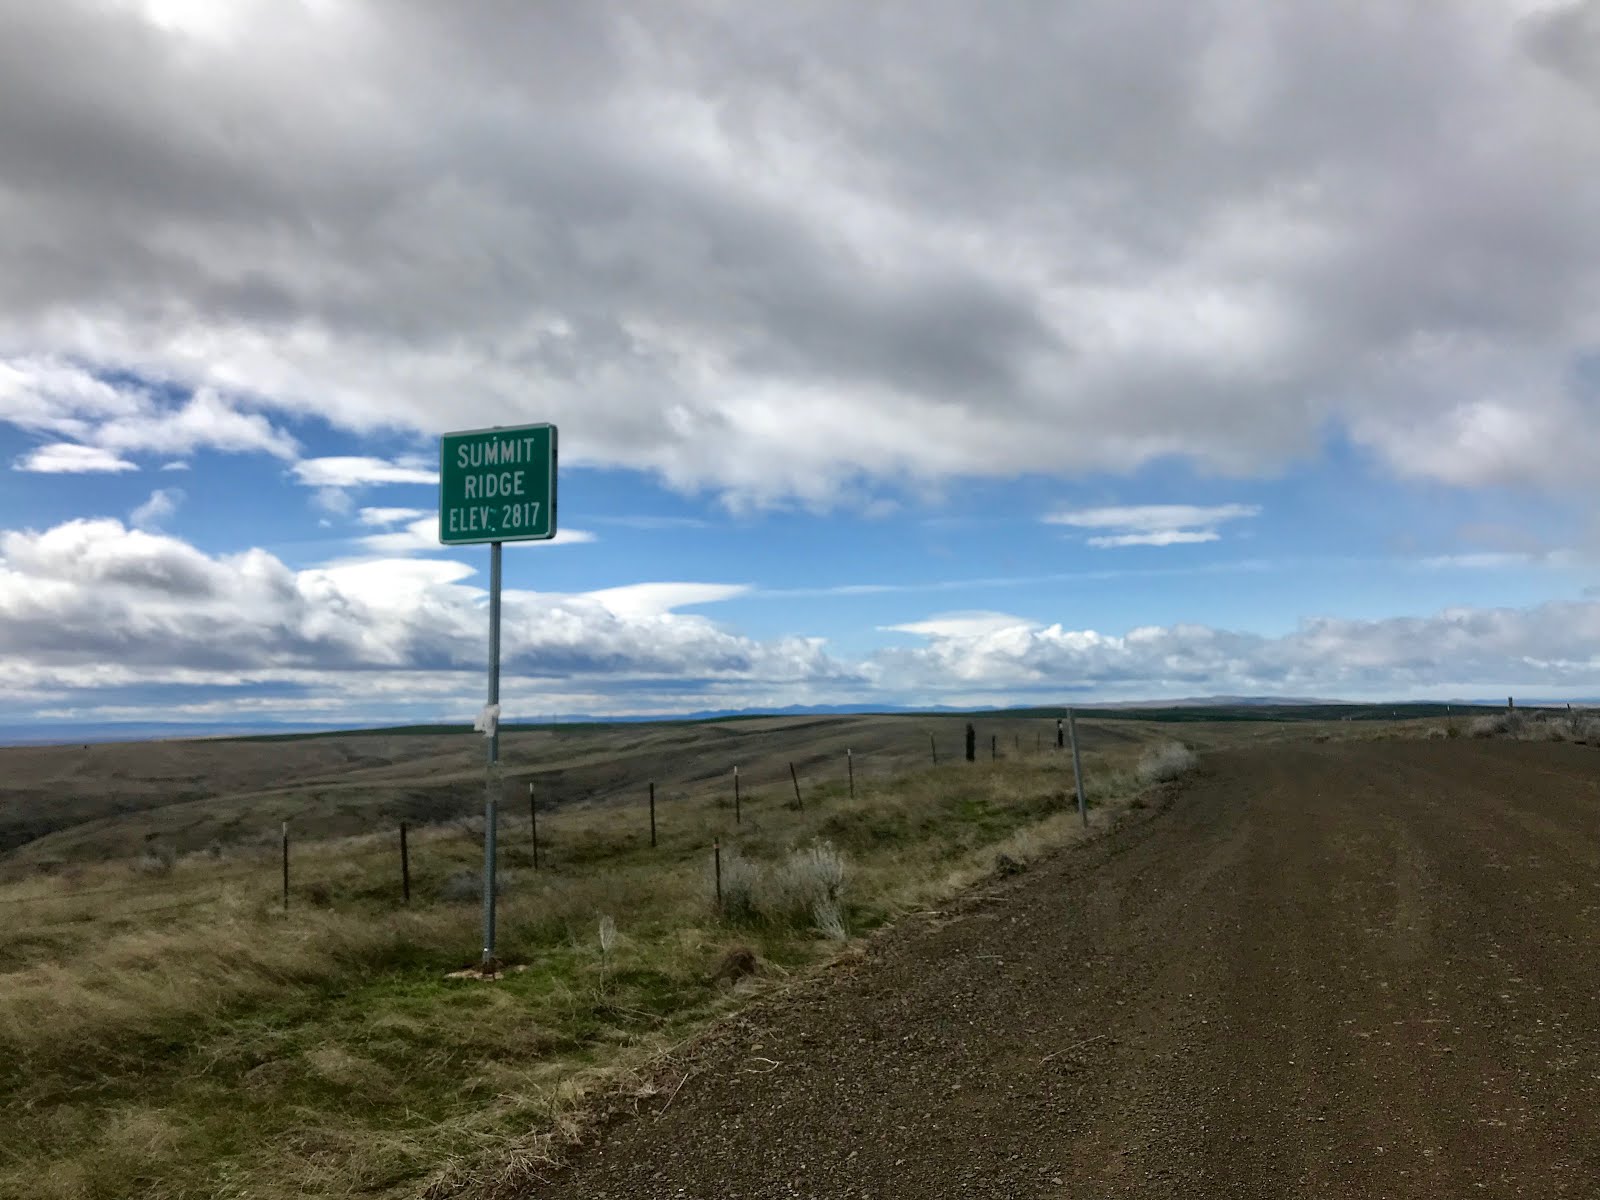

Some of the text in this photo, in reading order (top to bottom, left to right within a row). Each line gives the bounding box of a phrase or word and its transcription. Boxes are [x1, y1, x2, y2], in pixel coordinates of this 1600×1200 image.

[457, 438, 534, 468] SUMMIT
[465, 471, 525, 499] RIDGE
[502, 502, 540, 528] 2817
